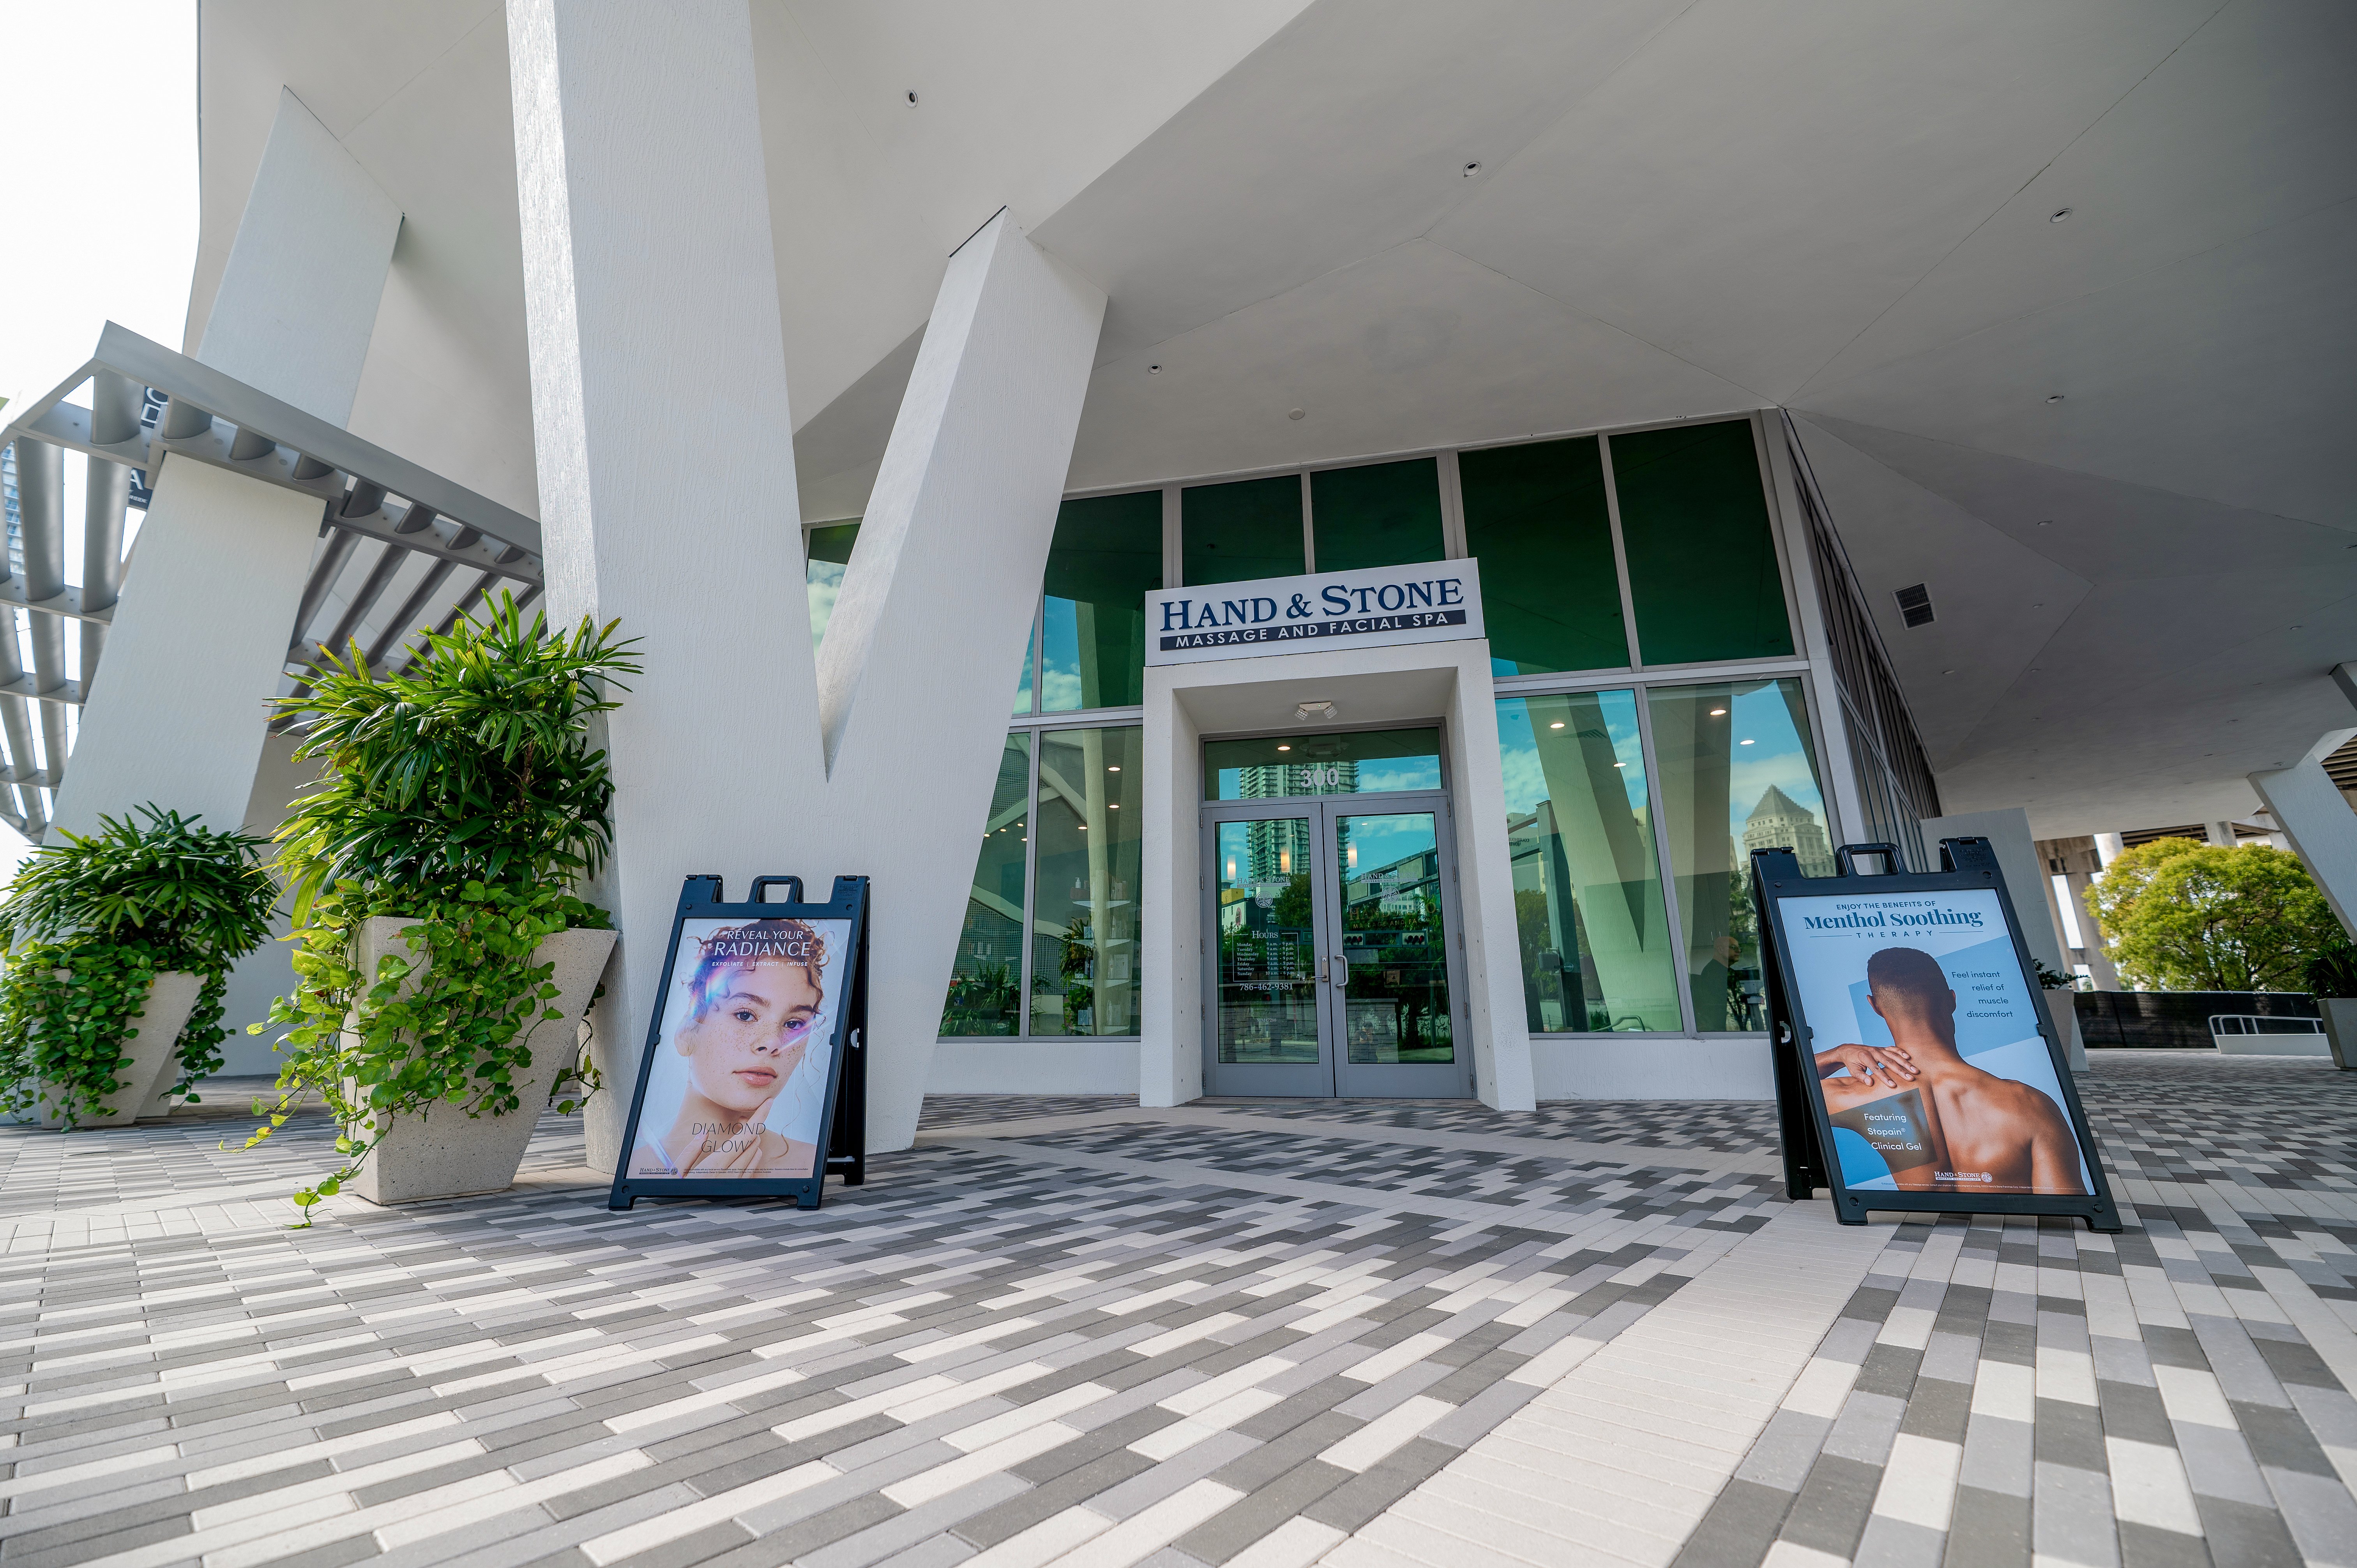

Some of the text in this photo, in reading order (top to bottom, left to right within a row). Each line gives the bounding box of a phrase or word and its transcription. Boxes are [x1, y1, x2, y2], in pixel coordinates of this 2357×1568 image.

[1160, 578, 1464, 632] HAND & STONE
[1175, 613, 1448, 647] MASSAGE AND FACIAL SPA
[1300, 768, 1338, 787] 300
[1803, 909, 1983, 929] Menthol Soothing
[727, 931, 803, 939] REVEAL YOUR
[714, 942, 811, 956] RADIANCE
[1864, 1114, 1906, 1123] Featuring
[692, 1123, 766, 1135] DIAMOND
[1868, 1128, 1905, 1137] Stopain®
